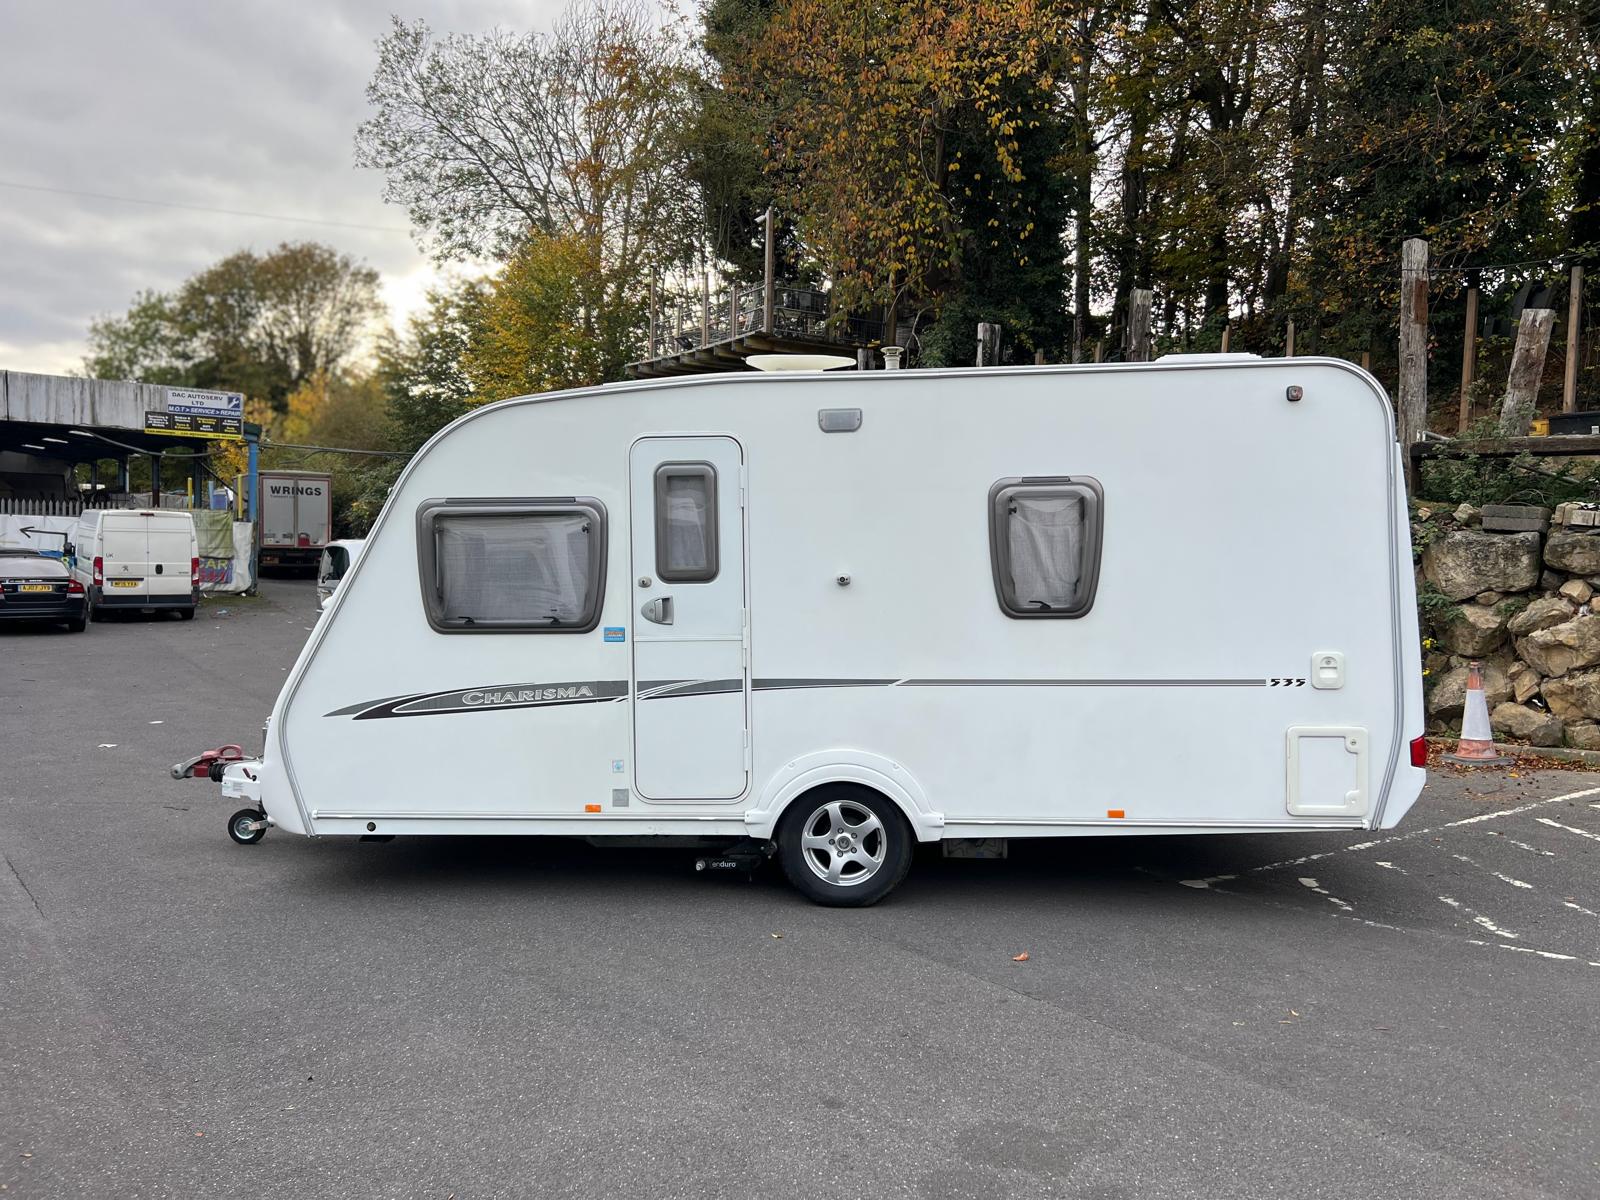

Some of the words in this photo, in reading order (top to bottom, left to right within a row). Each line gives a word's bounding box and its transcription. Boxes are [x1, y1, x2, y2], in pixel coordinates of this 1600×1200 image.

[187, 393, 223, 401] AUTOSERV
[270, 485, 322, 496] WRINGS
[1270, 678, 1306, 687] 535
[462, 685, 594, 705] CHARISMA
